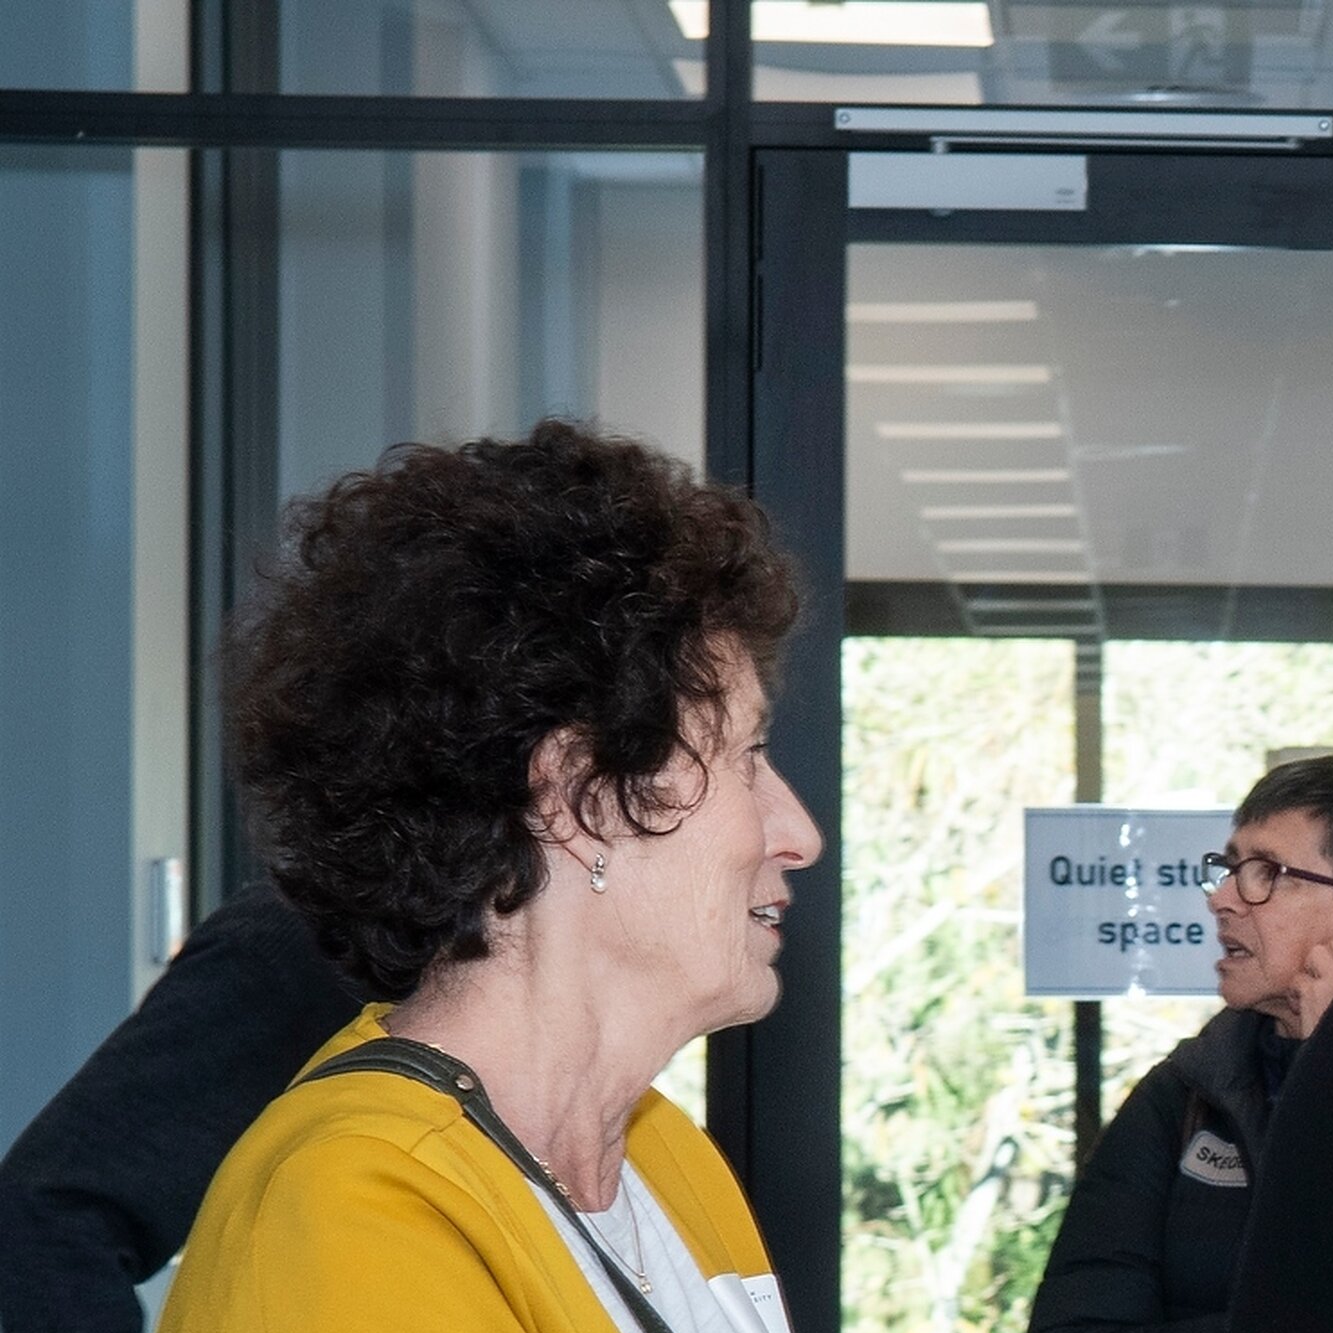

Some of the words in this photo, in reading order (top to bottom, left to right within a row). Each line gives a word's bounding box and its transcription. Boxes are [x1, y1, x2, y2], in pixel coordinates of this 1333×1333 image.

[1050, 855, 1142, 886] Quiet
[1157, 858, 1207, 886] stu
[1098, 921, 1204, 952] space
